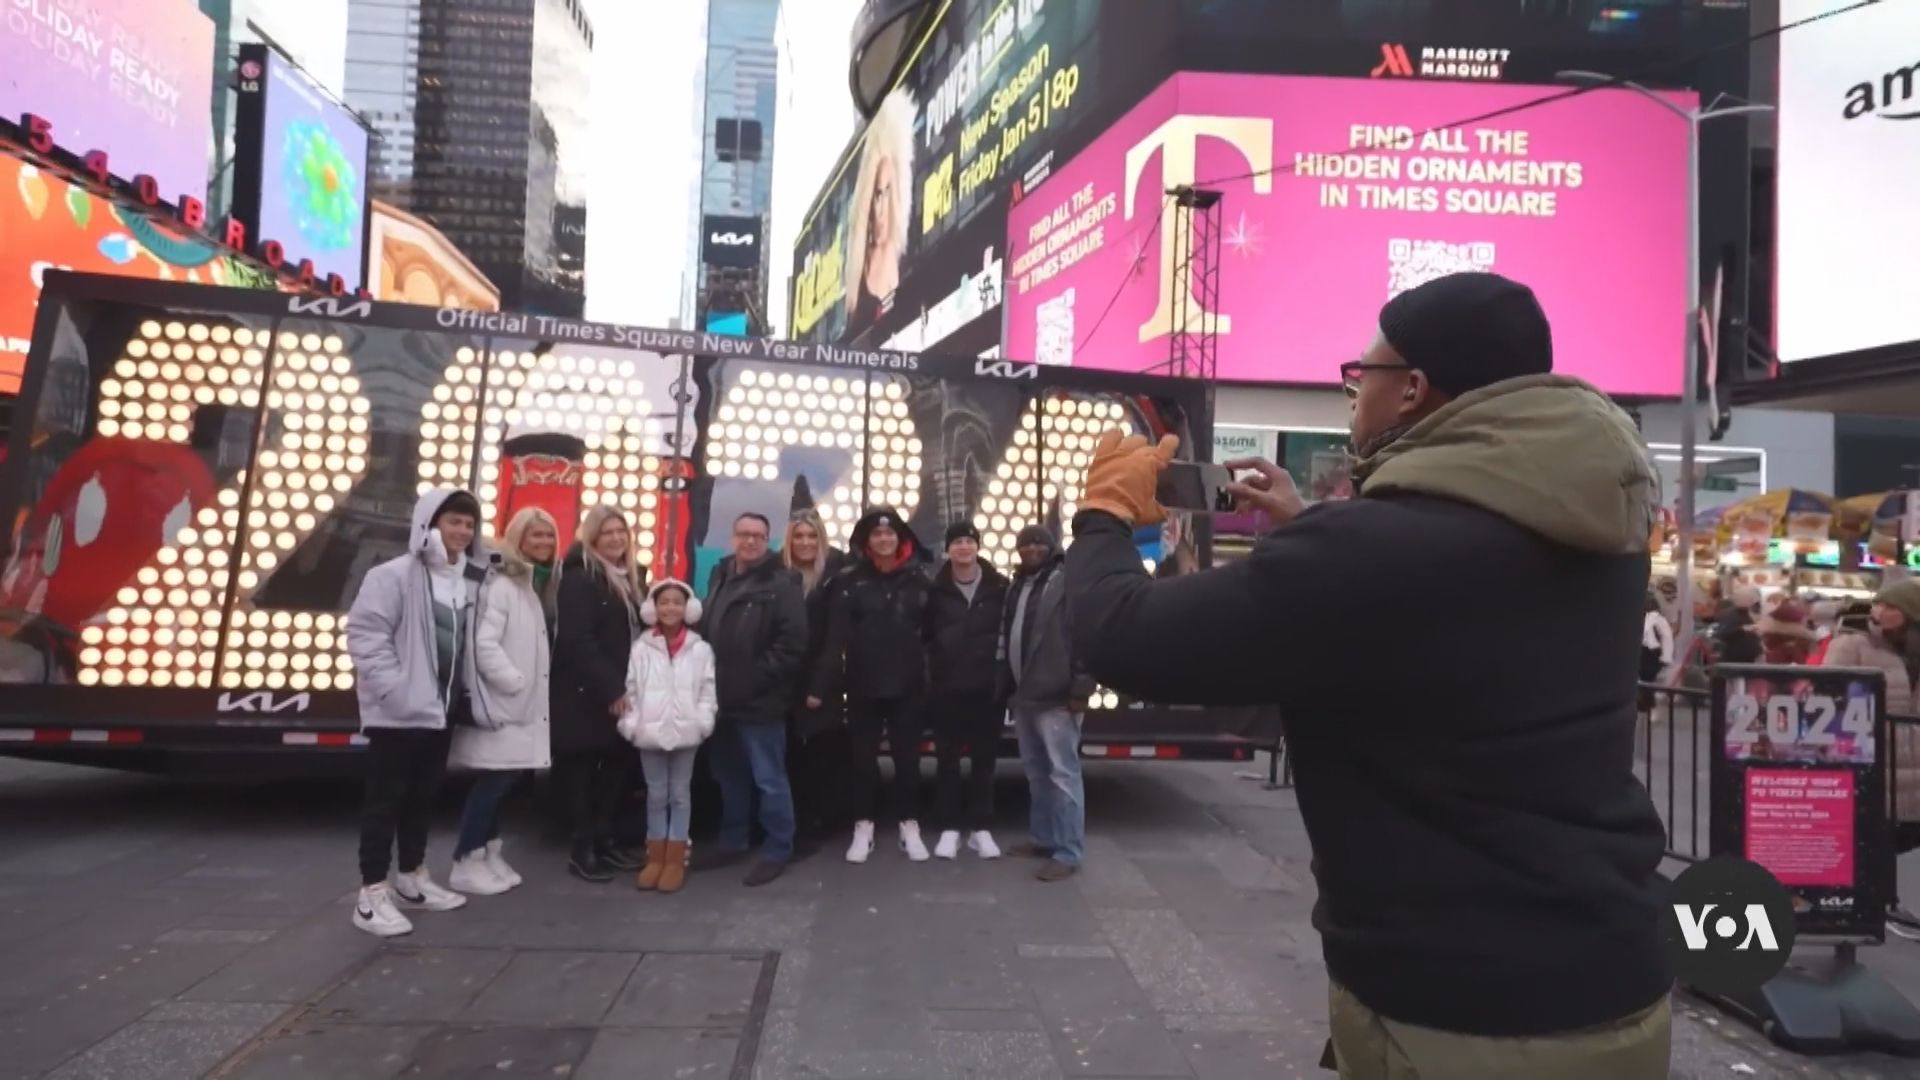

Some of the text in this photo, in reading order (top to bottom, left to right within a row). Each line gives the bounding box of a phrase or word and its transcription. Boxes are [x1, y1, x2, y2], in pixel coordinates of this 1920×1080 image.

[109, 47, 182, 108] READY
[1421, 62, 1500, 78] MARQUIS
[1422, 47, 1511, 62] MARRIOTT
[241, 82, 259, 91] LG
[926, 41, 978, 148] POWER
[961, 110, 990, 160] New
[990, 43, 1049, 126] Season
[958, 144, 1000, 200] Friday
[1000, 117, 1026, 163] Jan
[1027, 92, 1042, 133] 5
[1051, 64, 1079, 109] 8p
[1349, 124, 1529, 155] FIND ALL THE
[1295, 152, 1583, 188] HIDDEN ORNAMENTS
[1320, 184, 1556, 217] IN TIMES SQUARE
[1029, 181, 1094, 244] FIND ALL THE
[1047, 192, 1116, 255] ORNAMENTS
[1124, 114, 1274, 344] T
[1030, 255, 1059, 288] TIMES
[1060, 225, 1104, 269] SQUARE
[436, 306, 919, 369] Official Times Square New Year Numerals
[1726, 694, 1873, 746] 2024
